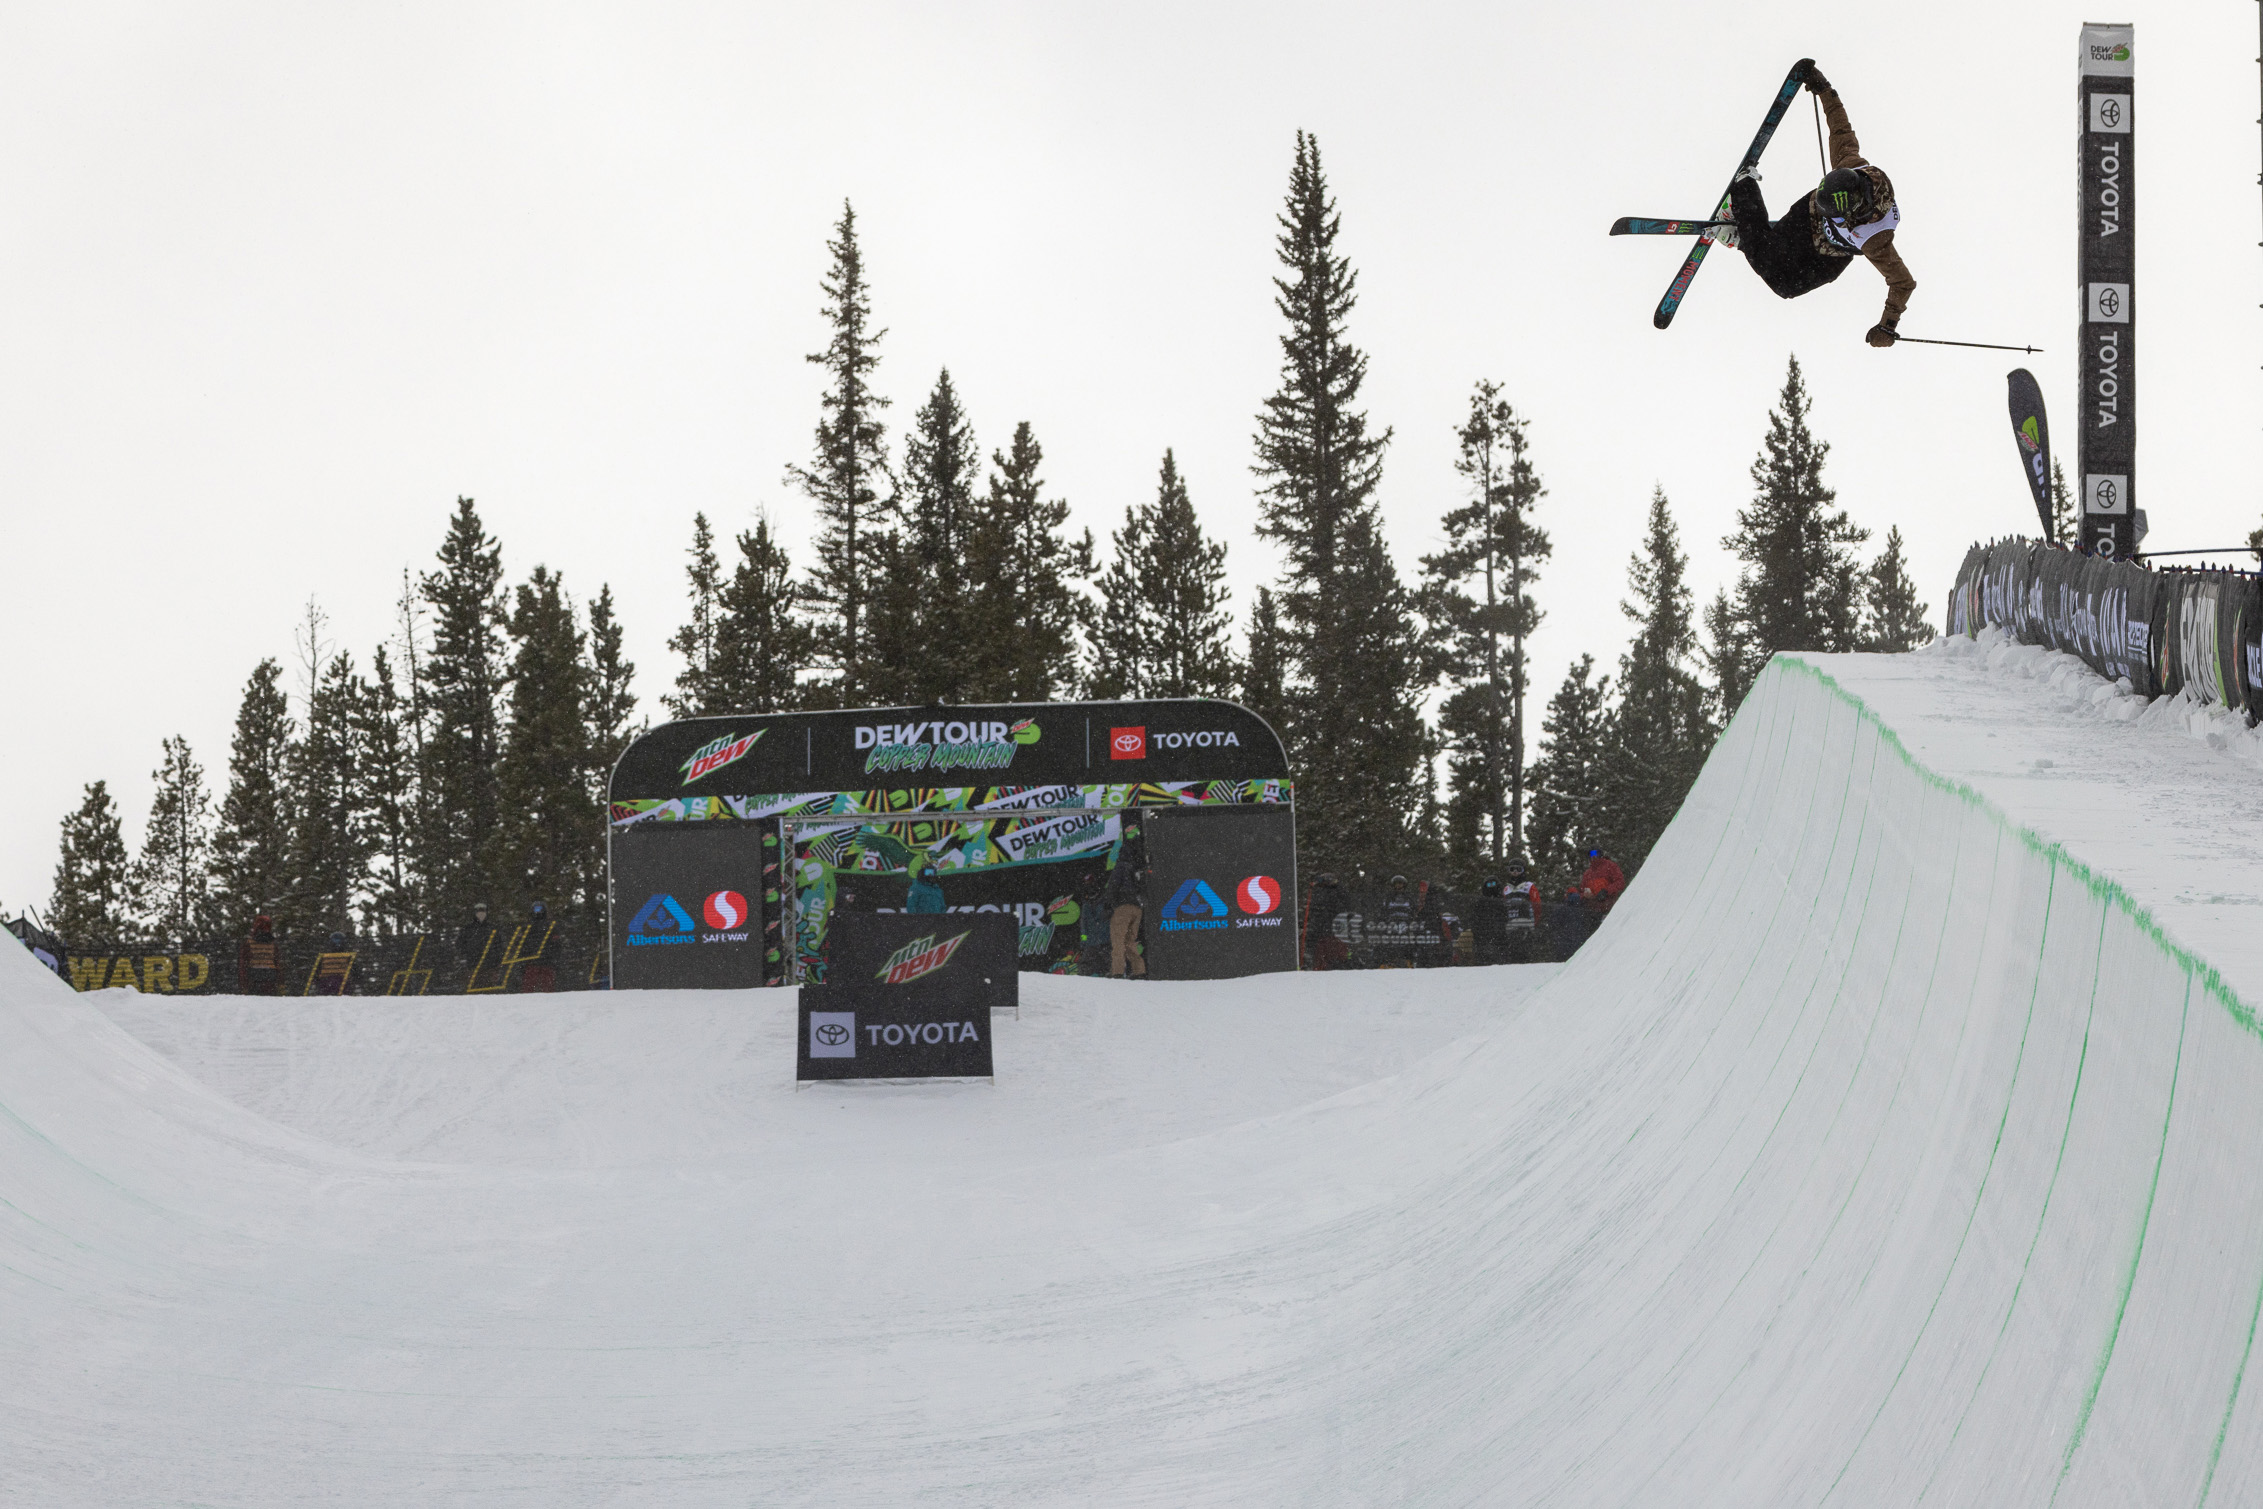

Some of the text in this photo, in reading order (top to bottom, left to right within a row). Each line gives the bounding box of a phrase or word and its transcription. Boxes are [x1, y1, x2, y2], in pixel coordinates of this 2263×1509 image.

[2091, 52, 2114, 60] TOUR
[2101, 141, 2119, 237] TOYOTA
[1669, 261, 1699, 302] MOMENT
[2099, 331, 2118, 428] TOYOTA
[2097, 523, 2115, 561] TO
[1153, 731, 1240, 749] TOYOTA
[865, 735, 1018, 774] COPPER MOUNTAIN
[1160, 917, 1283, 931] Albertsons SAFEWAY
[1366, 920, 1425, 935] copper
[627, 932, 749, 946] Albertsons SAFEWAY
[1368, 929, 1440, 944] mountain
[865, 1021, 979, 1046] TOYOTA
